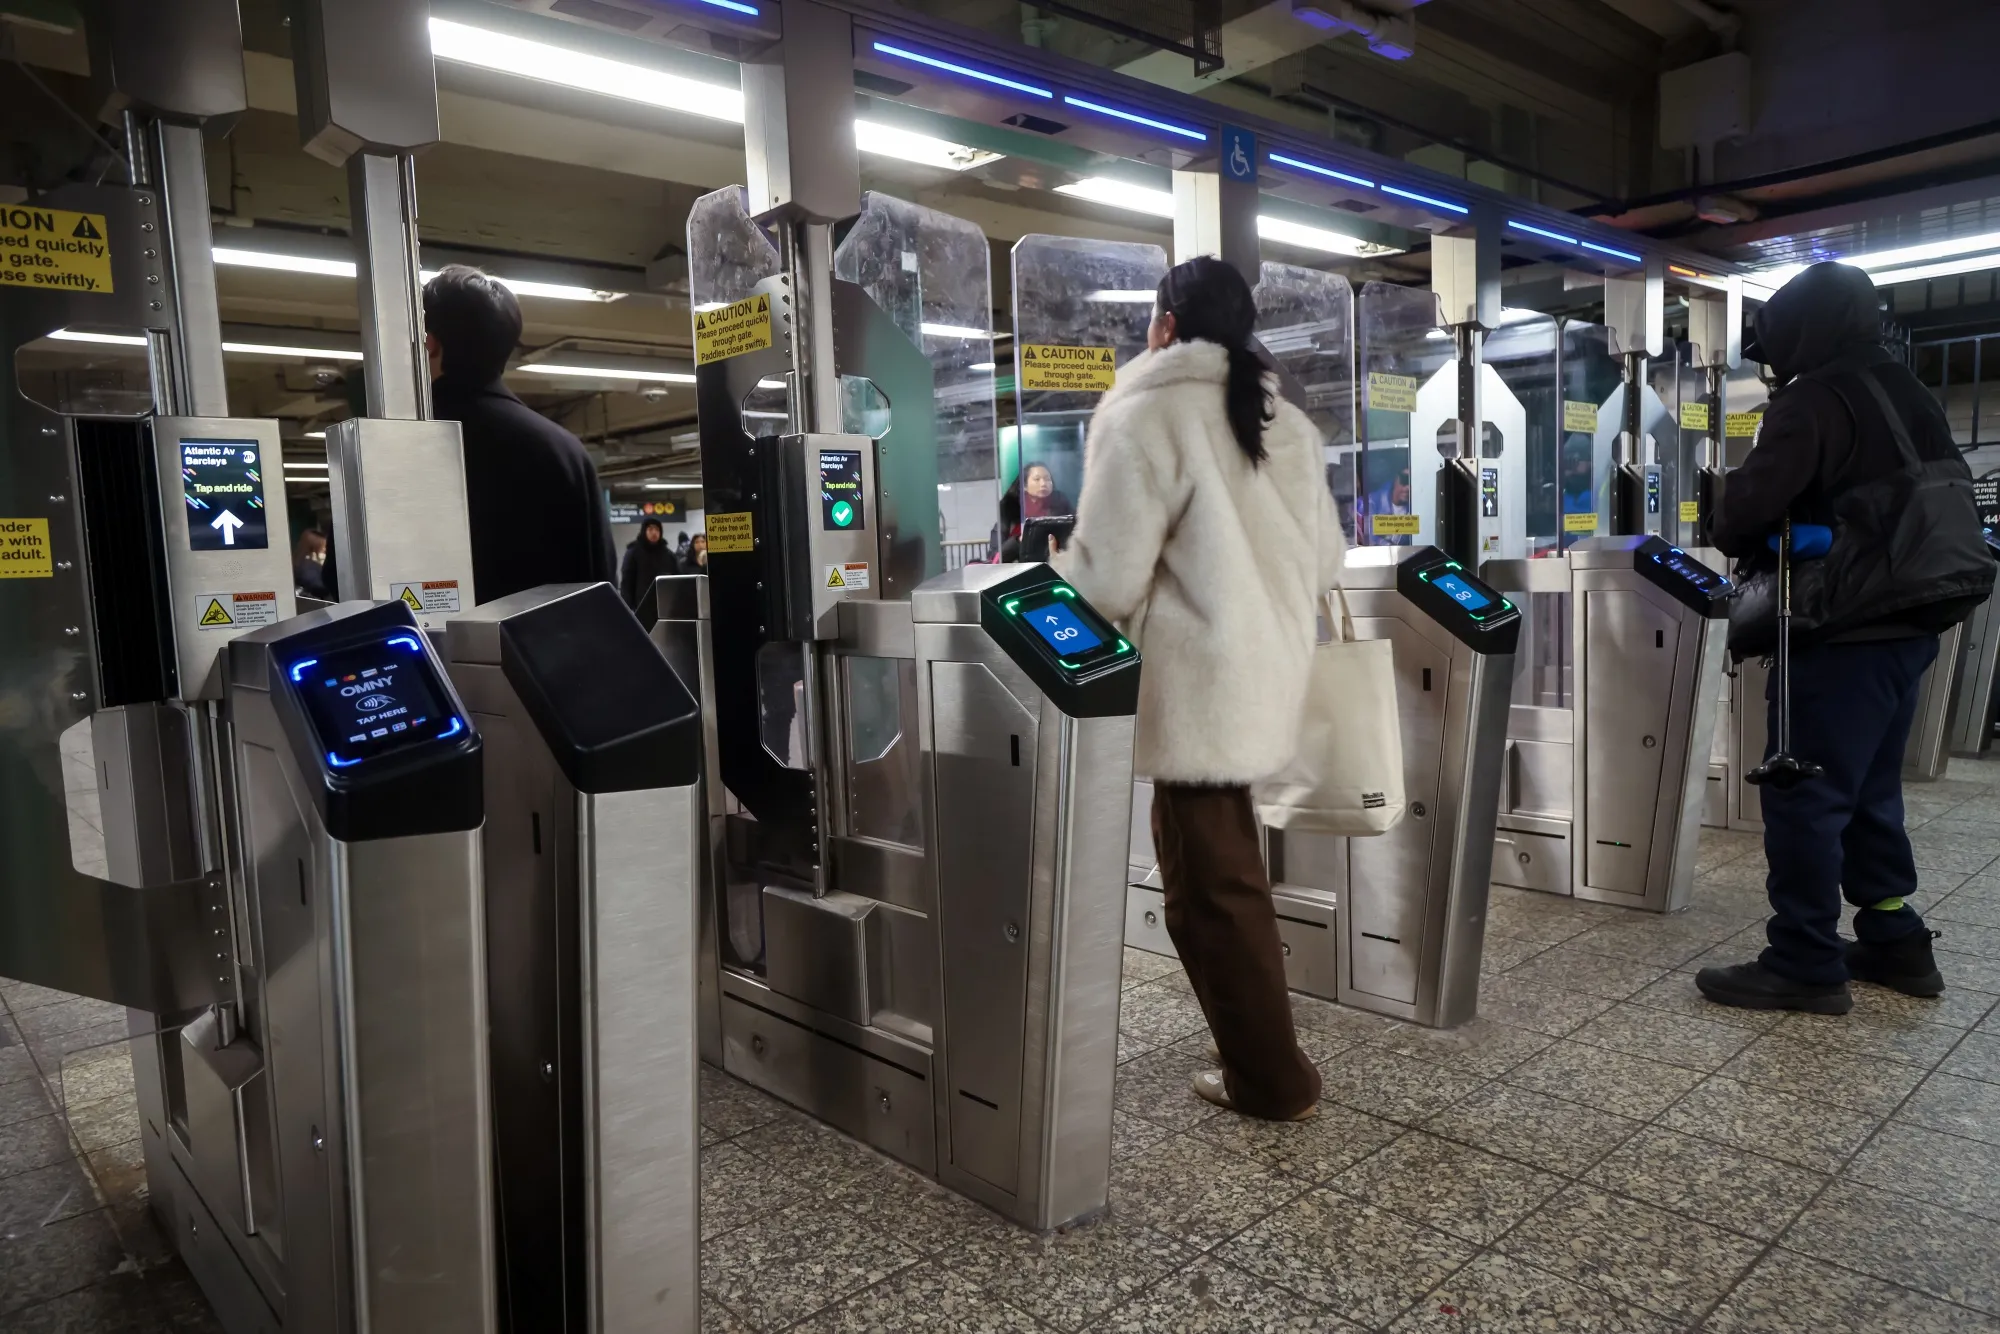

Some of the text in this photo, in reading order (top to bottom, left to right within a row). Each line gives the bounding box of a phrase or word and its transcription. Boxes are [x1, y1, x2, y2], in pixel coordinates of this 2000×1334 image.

[0, 208, 54, 232] ION
[0, 234, 104, 258] ed quickly
[10, 254, 59, 268] gate.
[0, 270, 99, 290] se swiftly.
[709, 301, 752, 325] CAUTION
[697, 313, 768, 340] Please proceed quickly
[712, 330, 753, 347] through gate.
[701, 338, 768, 361] Paddles close swiftly.
[1042, 348, 1094, 360] CAUTION
[1024, 360, 1051, 368] Please
[1087, 363, 1113, 372] quickly
[1044, 371, 1096, 380] through gate.
[1380, 376, 1406, 387] CAUTION
[1029, 380, 1060, 388] Paddles
[1085, 382, 1110, 390] swiftly.
[185, 446, 235, 455] Atlantic Av
[185, 457, 227, 467] Barclays
[194, 484, 253, 494] Tap and ride
[9, 535, 42, 546] with
[2, 549, 45, 560] adult.
[1456, 591, 1472, 600] GO
[1054, 627, 1078, 640] GO
[340, 676, 392, 696] OMNY
[357, 707, 408, 725] TAP HERE
